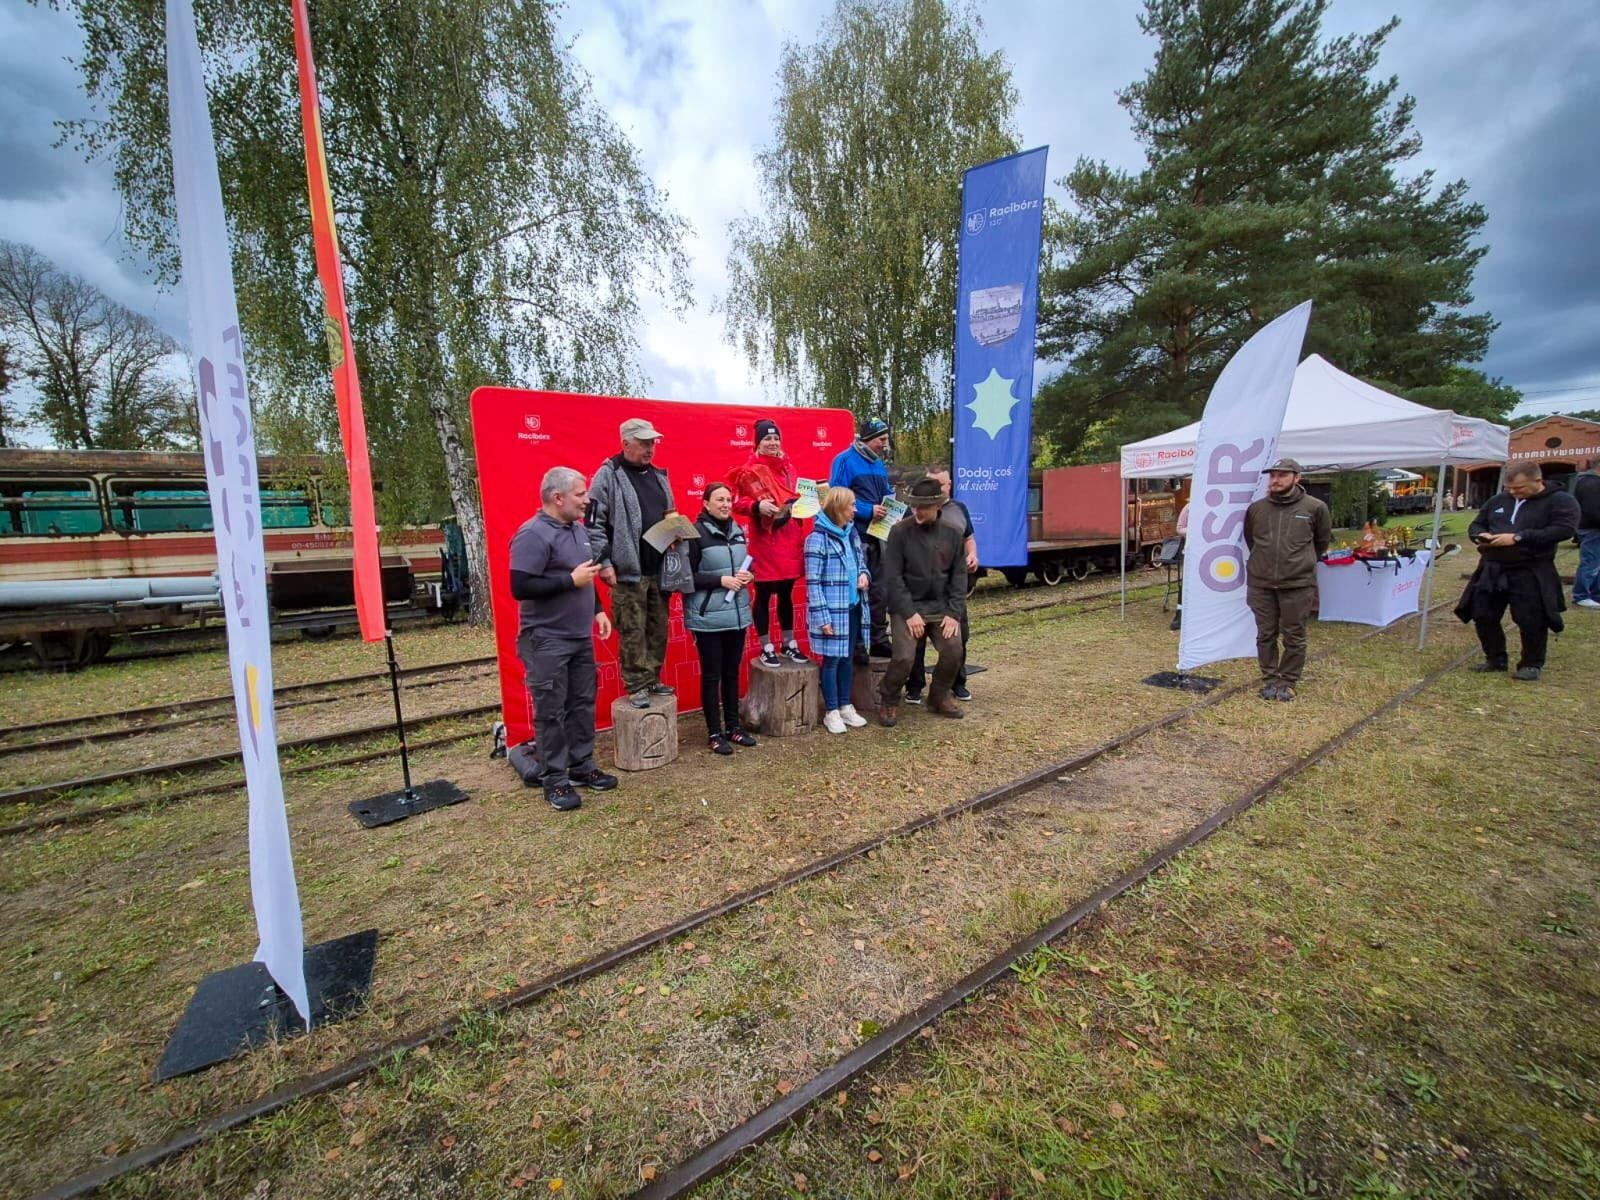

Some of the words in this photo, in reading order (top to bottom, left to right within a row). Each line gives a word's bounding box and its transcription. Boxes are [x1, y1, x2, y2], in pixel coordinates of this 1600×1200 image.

[989, 199, 1039, 218] Racibórz
[1157, 448, 1194, 459] Racibó
[958, 467, 992, 479] Dodaj
[971, 480, 999, 491] siebie
[1199, 438, 1265, 592] OSiR
[786, 684, 809, 728] 1
[638, 712, 669, 760] 2
